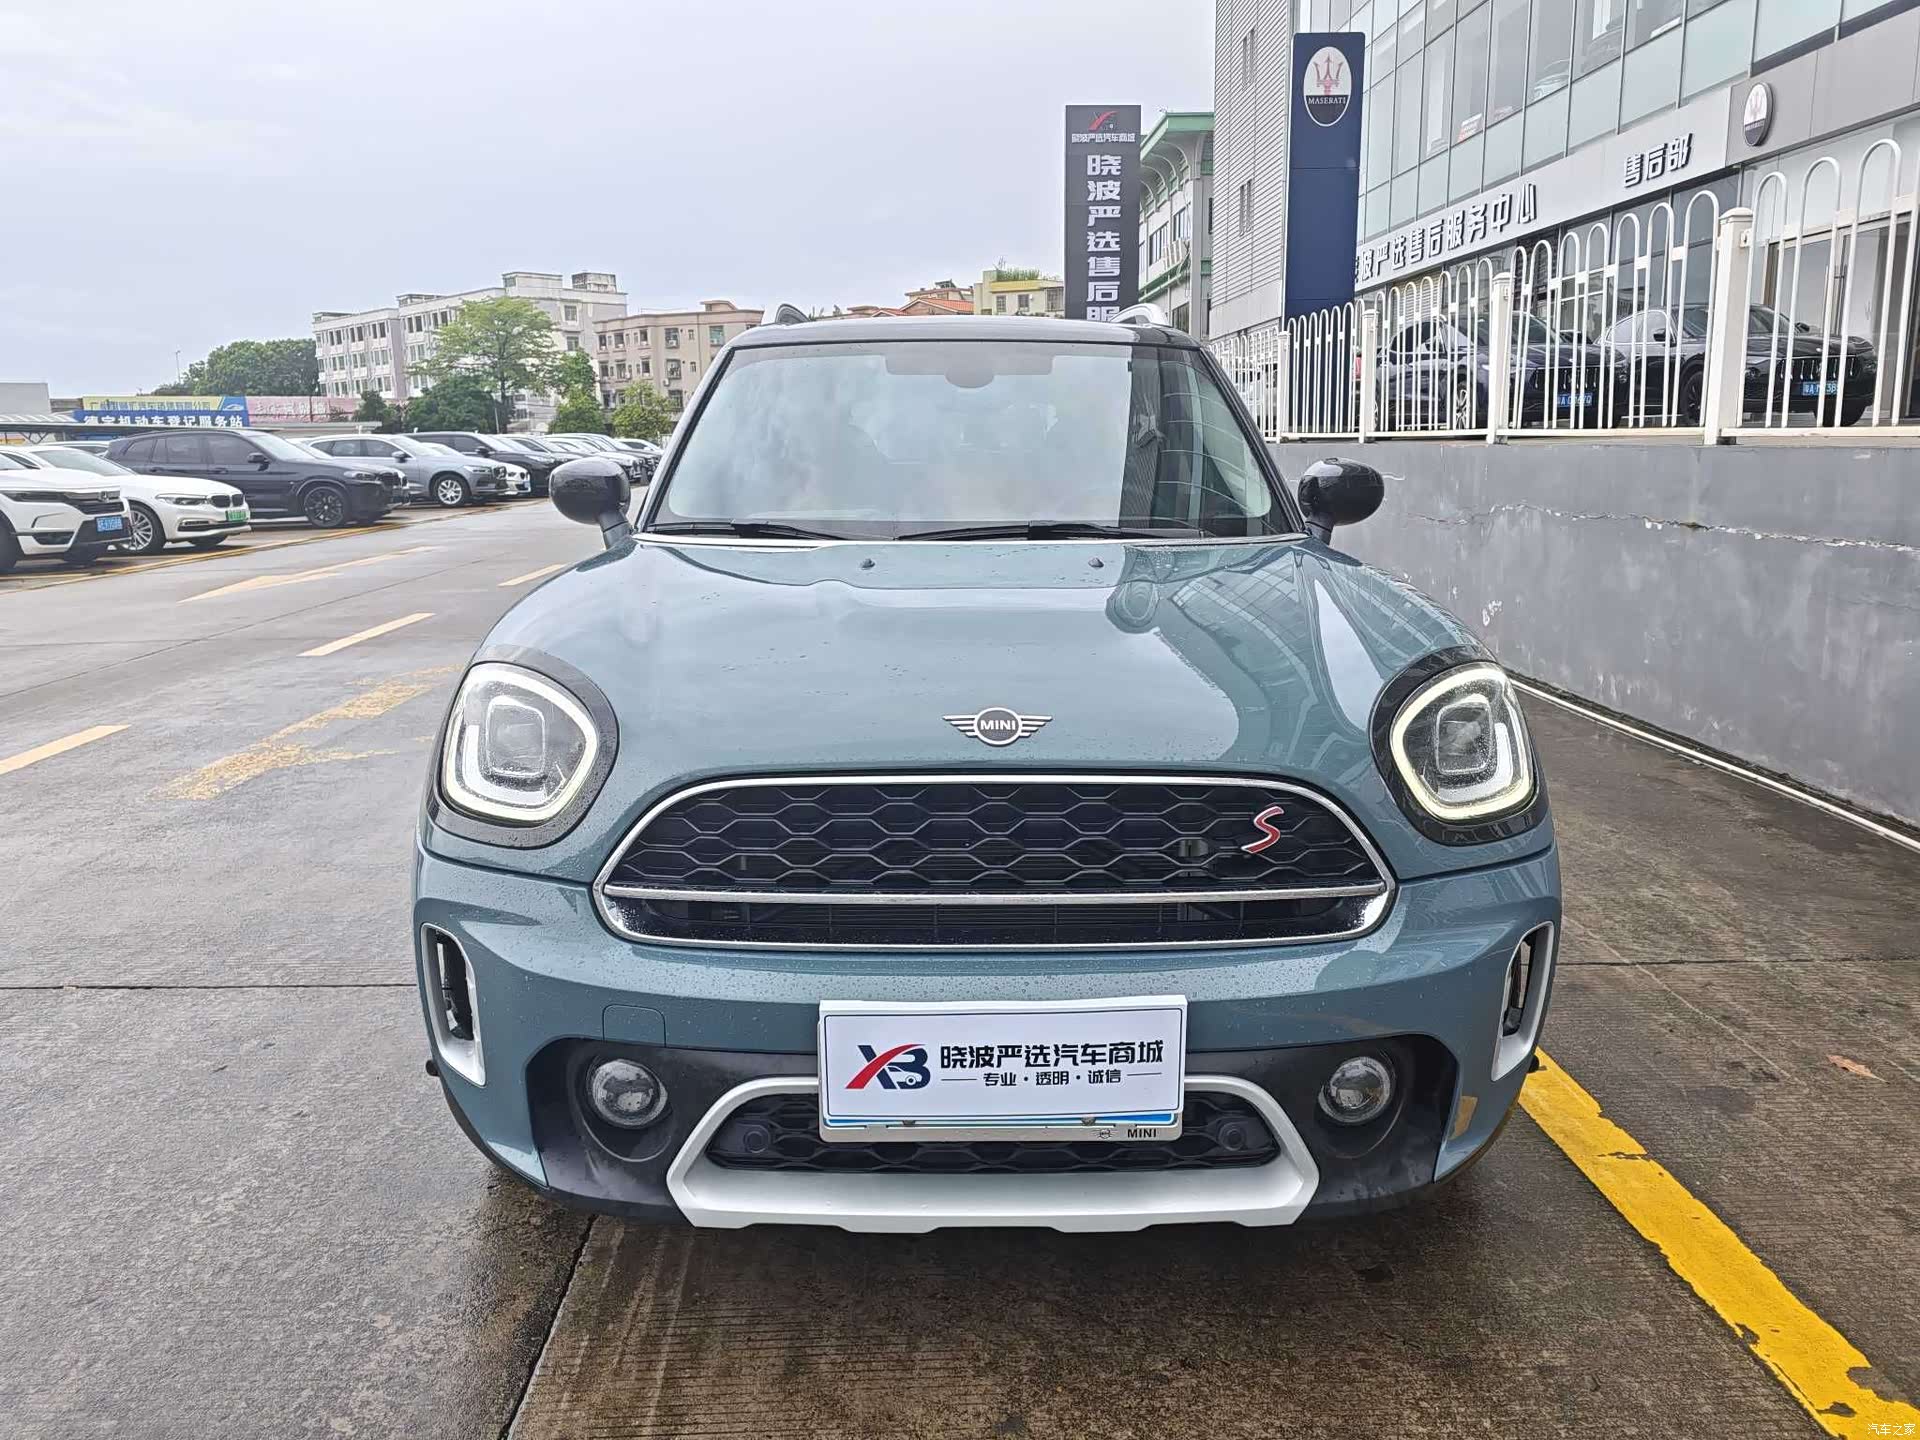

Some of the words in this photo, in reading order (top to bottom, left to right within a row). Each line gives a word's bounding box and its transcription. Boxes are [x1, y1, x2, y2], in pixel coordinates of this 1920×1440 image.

[1308, 96, 1346, 104] MASERATI
[1623, 132, 1694, 188] 售后部
[980, 719, 1016, 731] MINI
[1241, 806, 1285, 853] S
[940, 1040, 1164, 1069] 晓波严选汽车商城
[1127, 1128, 1157, 1138] MINI
